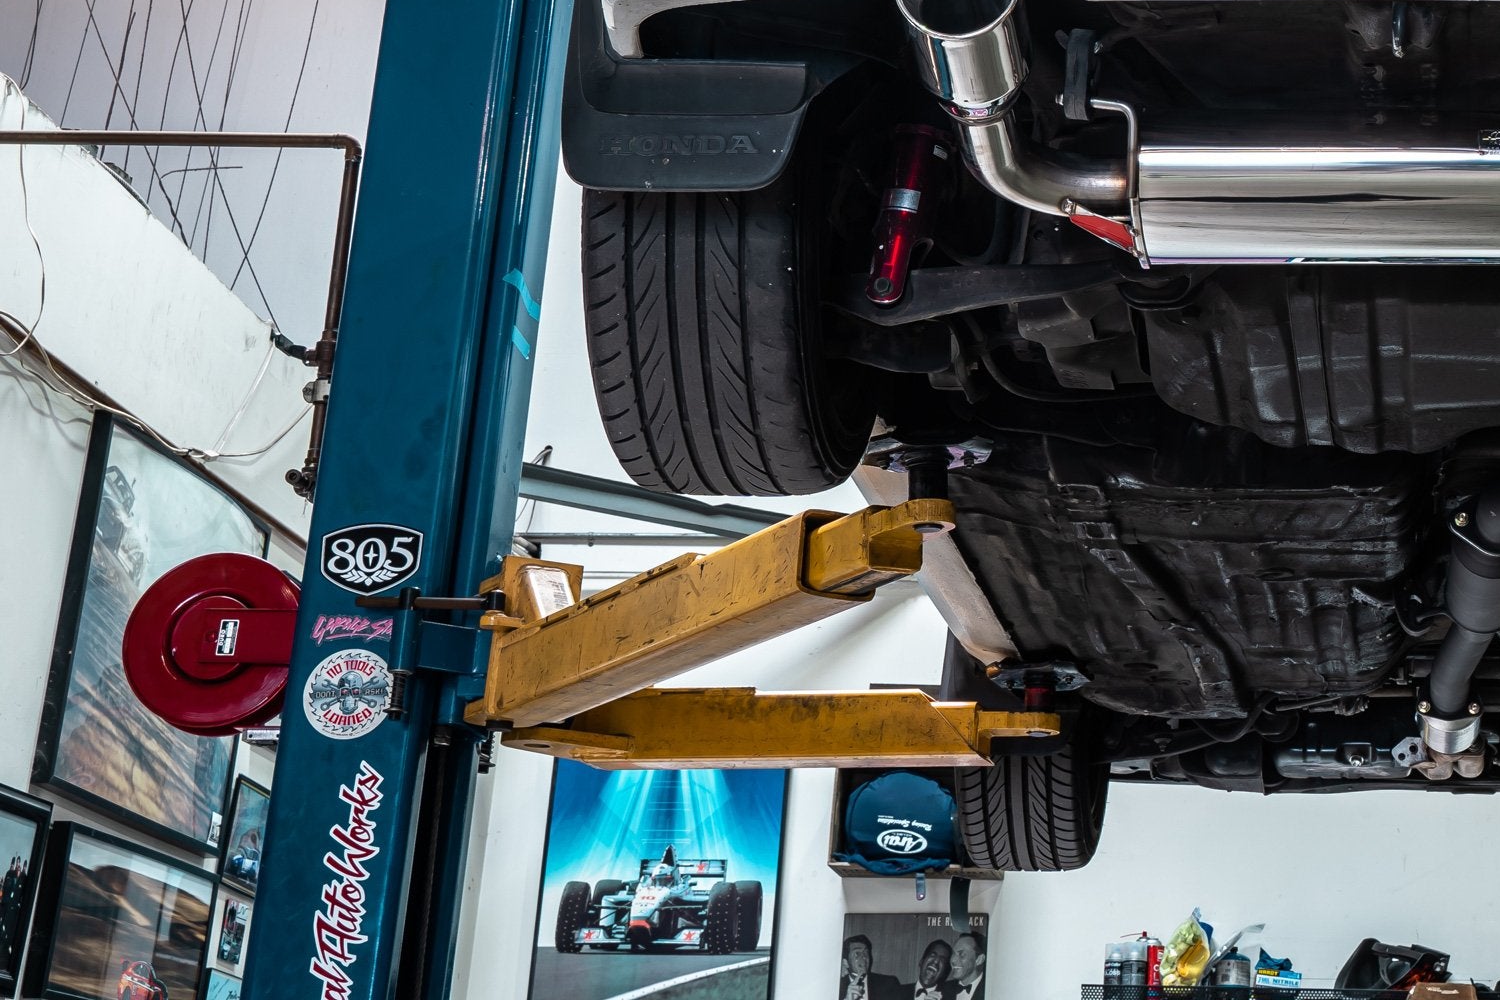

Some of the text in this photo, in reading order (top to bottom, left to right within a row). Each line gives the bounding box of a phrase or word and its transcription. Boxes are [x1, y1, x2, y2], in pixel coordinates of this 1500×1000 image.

[600, 134, 760, 157] HONDA
[326, 536, 415, 574] 805
[326, 659, 377, 679] NO TOOLS
[322, 707, 373, 726] LOANED
[882, 834, 923, 853] Arai
[927, 916, 941, 927] THE
[1273, 978, 1299, 986] NITRILE
